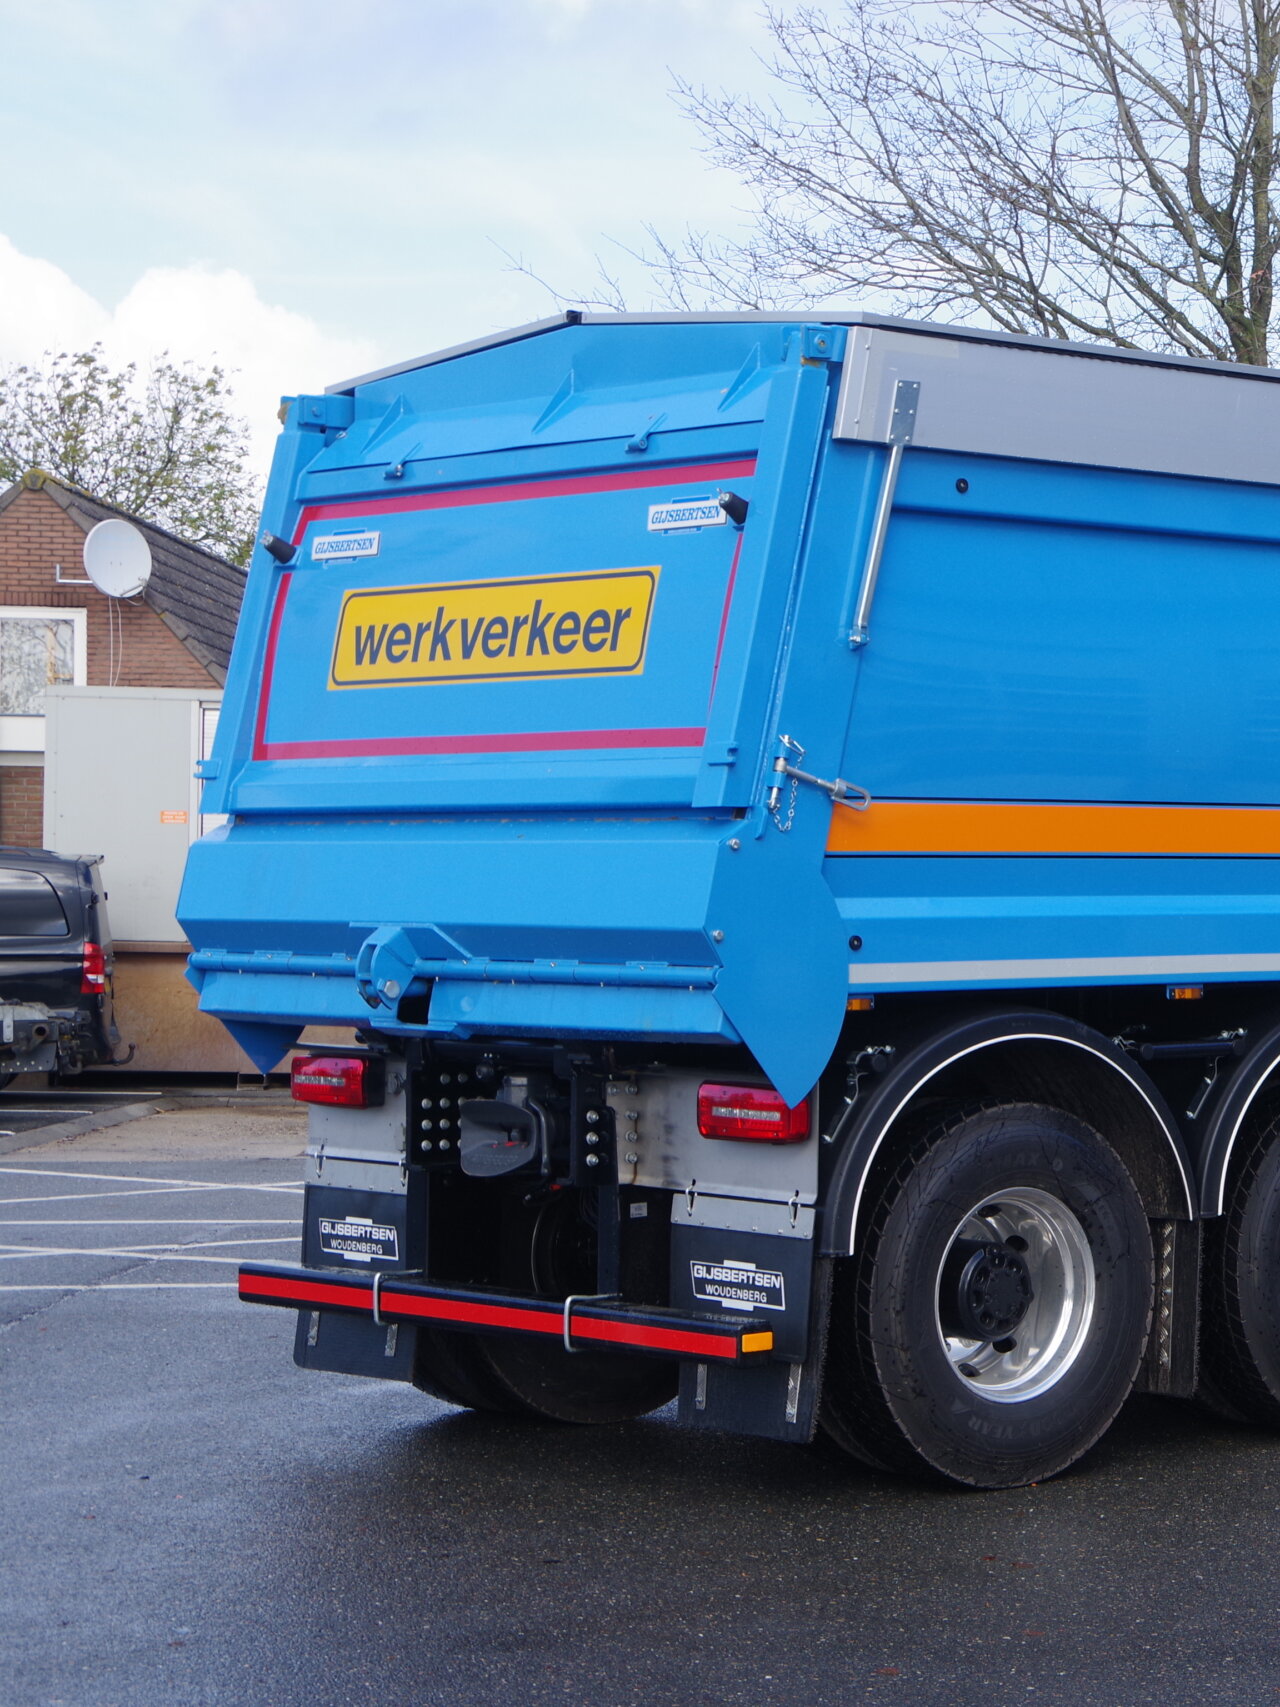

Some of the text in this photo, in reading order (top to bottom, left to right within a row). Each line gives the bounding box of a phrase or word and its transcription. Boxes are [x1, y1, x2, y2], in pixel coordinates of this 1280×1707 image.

[651, 505, 720, 524] GIJSBERTSEN
[314, 537, 375, 555] GIJSBERTSEN
[354, 599, 632, 666] werkverkeer
[321, 1221, 395, 1242] GIJSBERTSEN
[330, 1238, 383, 1256] WOUDENBERG
[693, 1264, 781, 1289] GIJSBERTSEN
[705, 1283, 768, 1303] WOUDENBERG
